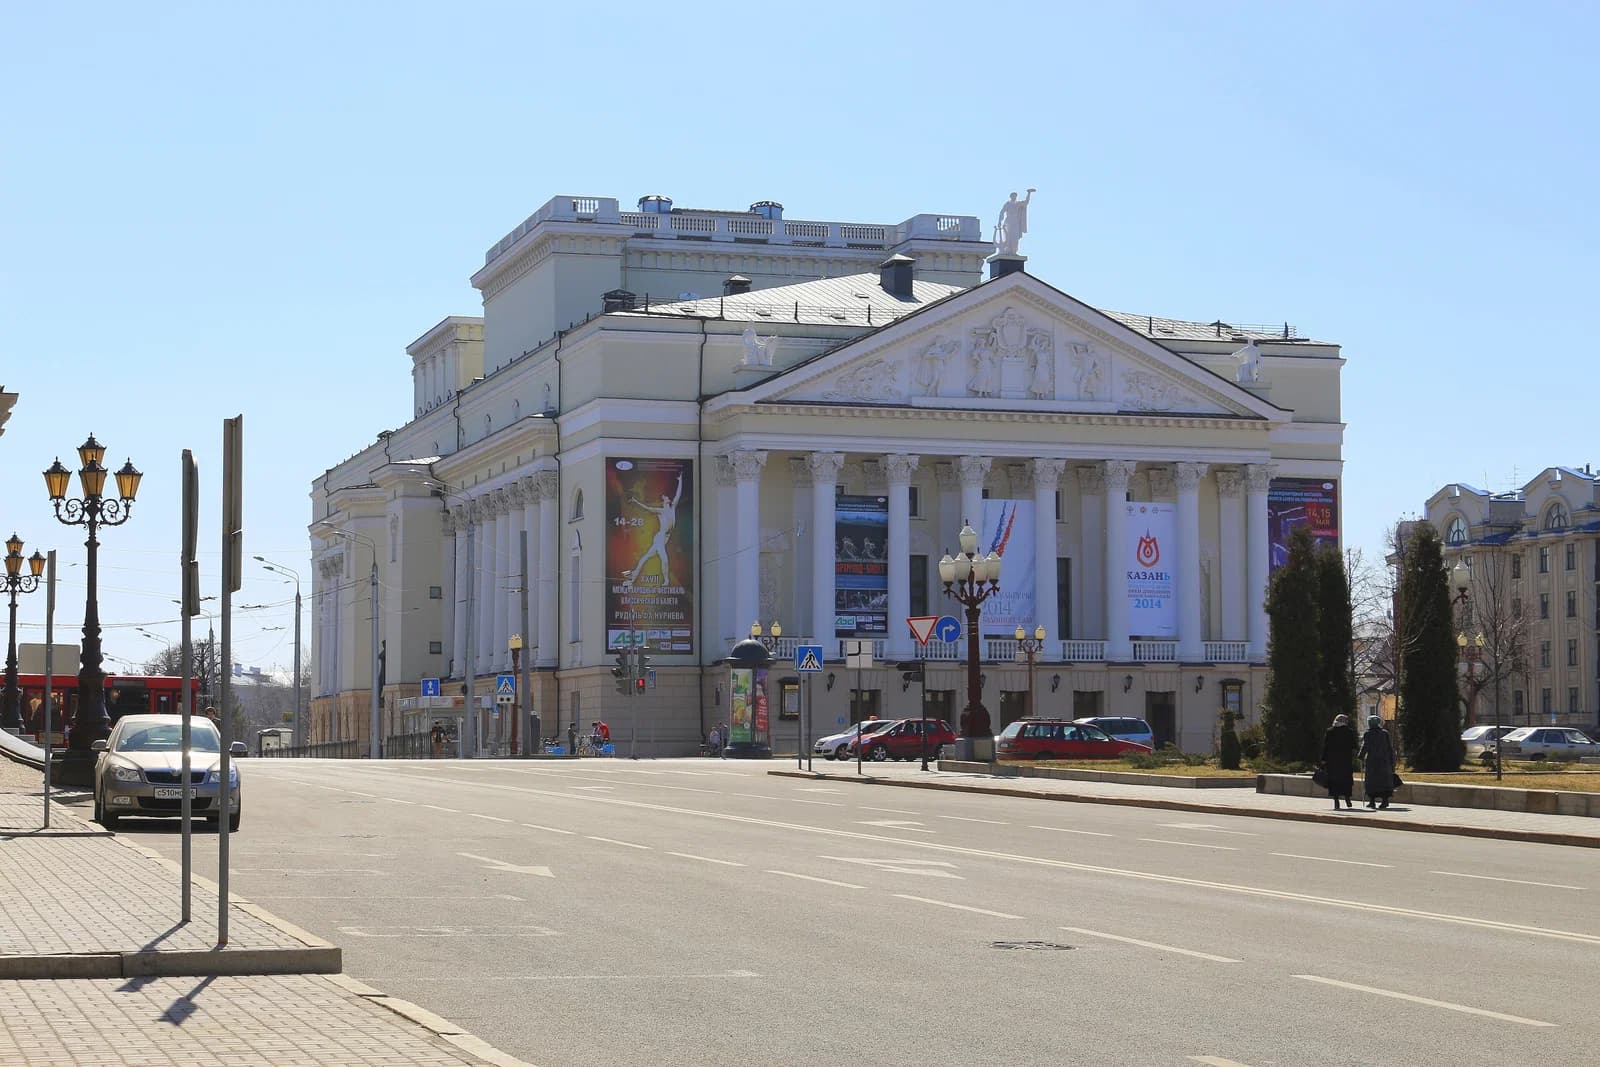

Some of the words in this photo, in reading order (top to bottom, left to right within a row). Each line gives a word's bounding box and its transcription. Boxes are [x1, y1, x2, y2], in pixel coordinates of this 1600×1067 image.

[1127, 571, 1170, 581] КАЗАНЬ
[1134, 598, 1162, 609] 2014
[655, 611, 684, 620] НУРИЕВА
